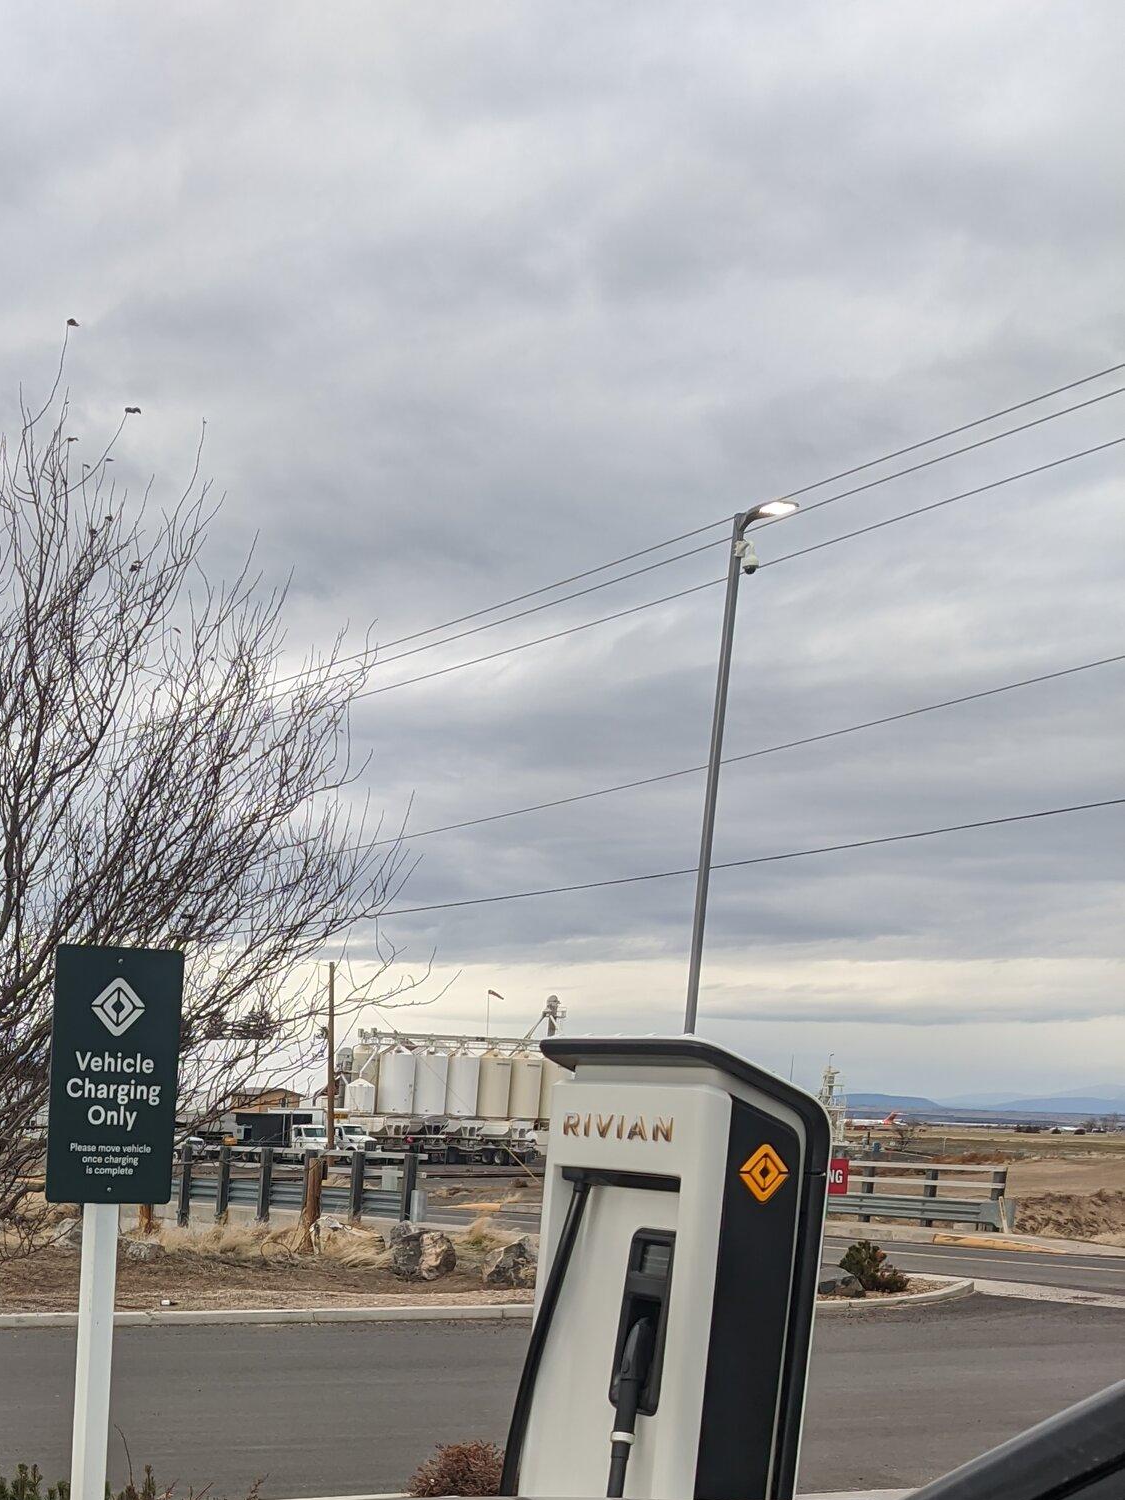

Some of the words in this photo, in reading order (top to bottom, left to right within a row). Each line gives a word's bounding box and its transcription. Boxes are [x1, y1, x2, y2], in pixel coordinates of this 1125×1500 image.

[75, 1050, 155, 1074] Vehicle
[66, 1077, 161, 1106] Charging
[87, 1105, 137, 1131] Only
[562, 1112, 674, 1142] RIVIAN
[70, 1142, 96, 1152] Please
[122, 1144, 151, 1153] vehicle
[82, 1156, 103, 1164] once
[104, 1155, 139, 1166] charging
[86, 1165, 93, 1174] is
[94, 1166, 134, 1177] complete
